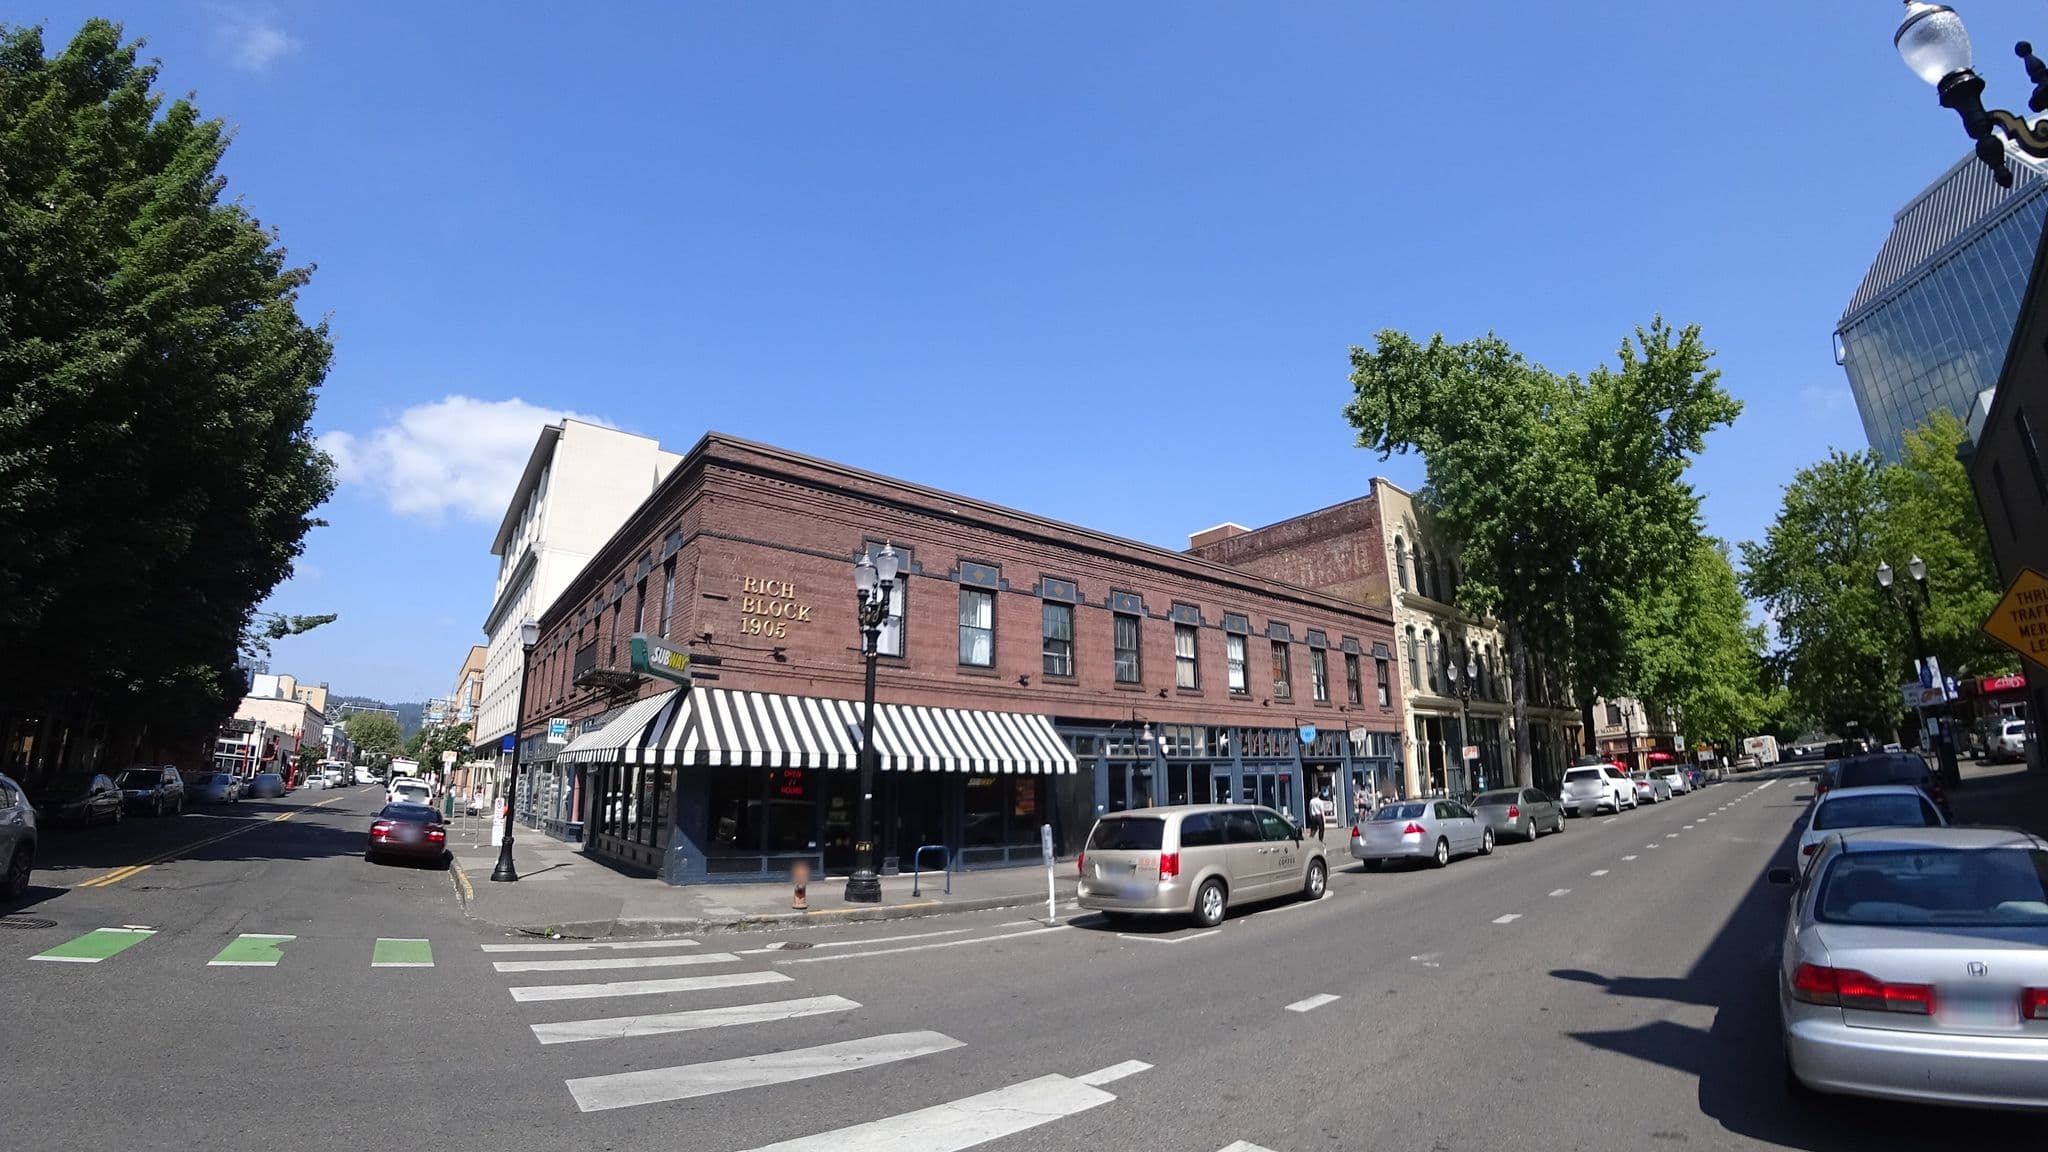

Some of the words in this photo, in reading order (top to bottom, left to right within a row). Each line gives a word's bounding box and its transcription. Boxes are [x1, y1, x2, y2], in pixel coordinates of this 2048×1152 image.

[743, 576, 796, 599] RICH
[741, 597, 812, 622] BLOCK
[740, 617, 788, 639] 1905
[2030, 638, 2048, 653] LE
[651, 646, 690, 672] SUBWAY
[784, 769, 801, 778] OPEN
